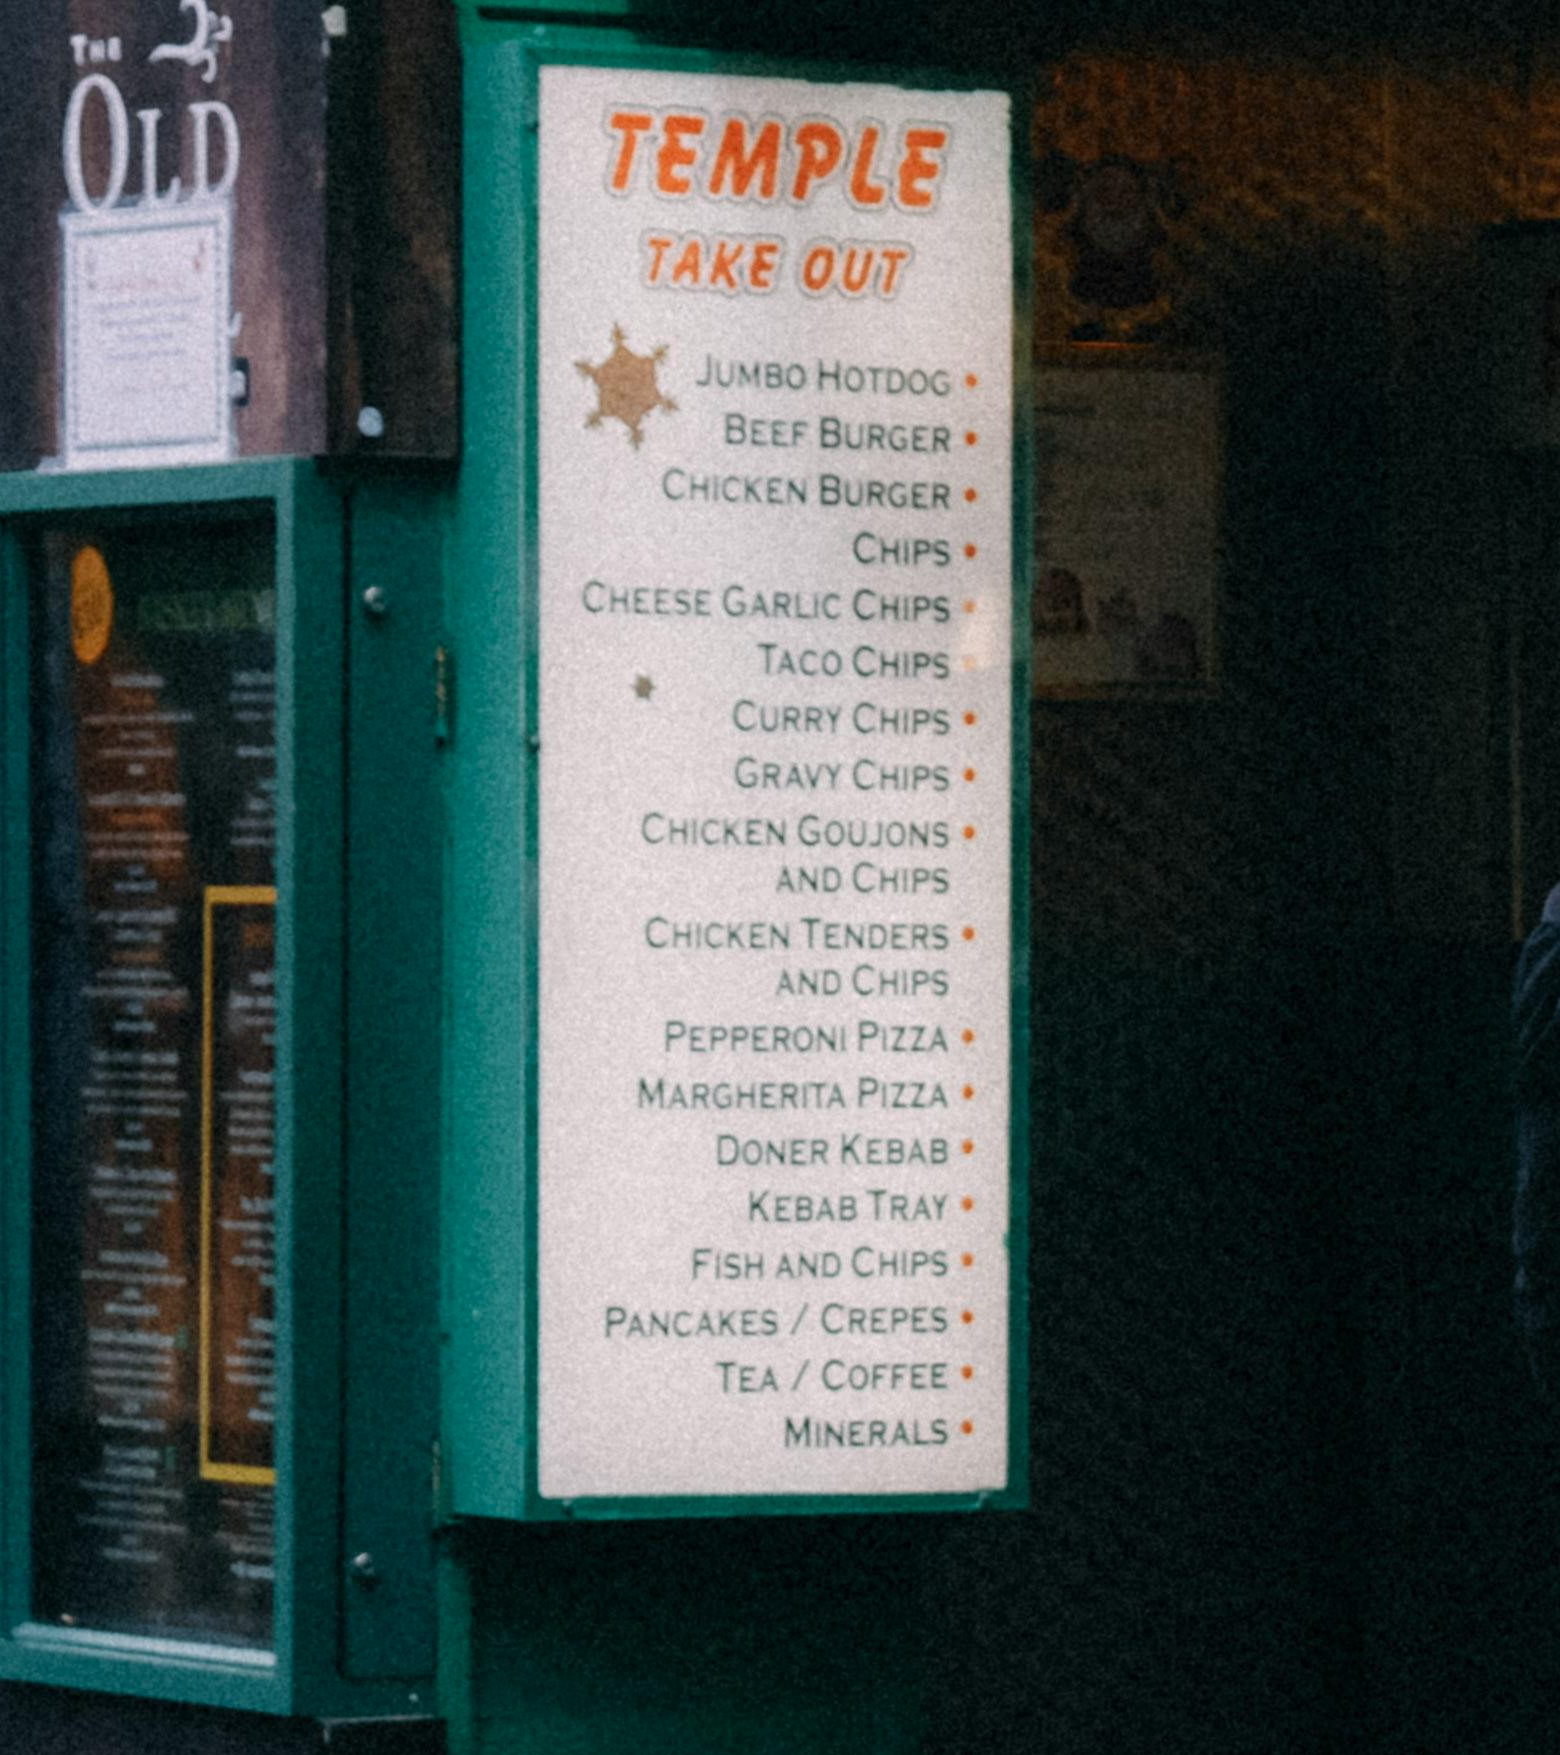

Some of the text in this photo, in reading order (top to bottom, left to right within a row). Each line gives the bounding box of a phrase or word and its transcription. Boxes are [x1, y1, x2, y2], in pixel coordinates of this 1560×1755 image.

[71, 34, 121, 65] THE
[64, 73, 239, 214] OLD
[610, 112, 947, 207] TEMPLE
[647, 237, 907, 296] TAKE OUT
[696, 353, 951, 396] JUMBO HOTDOG
[724, 412, 951, 453] BEEF BURGER
[662, 468, 951, 509] CHICKEN BURGER
[853, 532, 951, 566] CHIPS
[582, 580, 951, 622] CHEESE GARLIC CHIPS
[760, 642, 951, 678] TACO CHIPS
[732, 699, 951, 735] CURRY CHIPS
[734, 757, 951, 791] GRAVY CHIPS
[642, 812, 950, 848] CHICKEN GOUJONS
[776, 863, 950, 894] AND CHIPS
[645, 916, 949, 950] CHICKEN TENDERS
[776, 964, 949, 995] AND CHIPS
[665, 1021, 948, 1052] PEPPERONI PIZZA
[638, 1078, 948, 1109] MARGHERITA PIZZA
[717, 1135, 948, 1165] DONER KEBAB
[749, 1190, 948, 1221] KEBAB TRAY
[692, 1247, 948, 1279] FISH AND CHIPS
[604, 1304, 948, 1337] PANCAKES / CREPES
[716, 1359, 948, 1393] TEA / COFFEE
[785, 1418, 948, 1448] MINERALS
